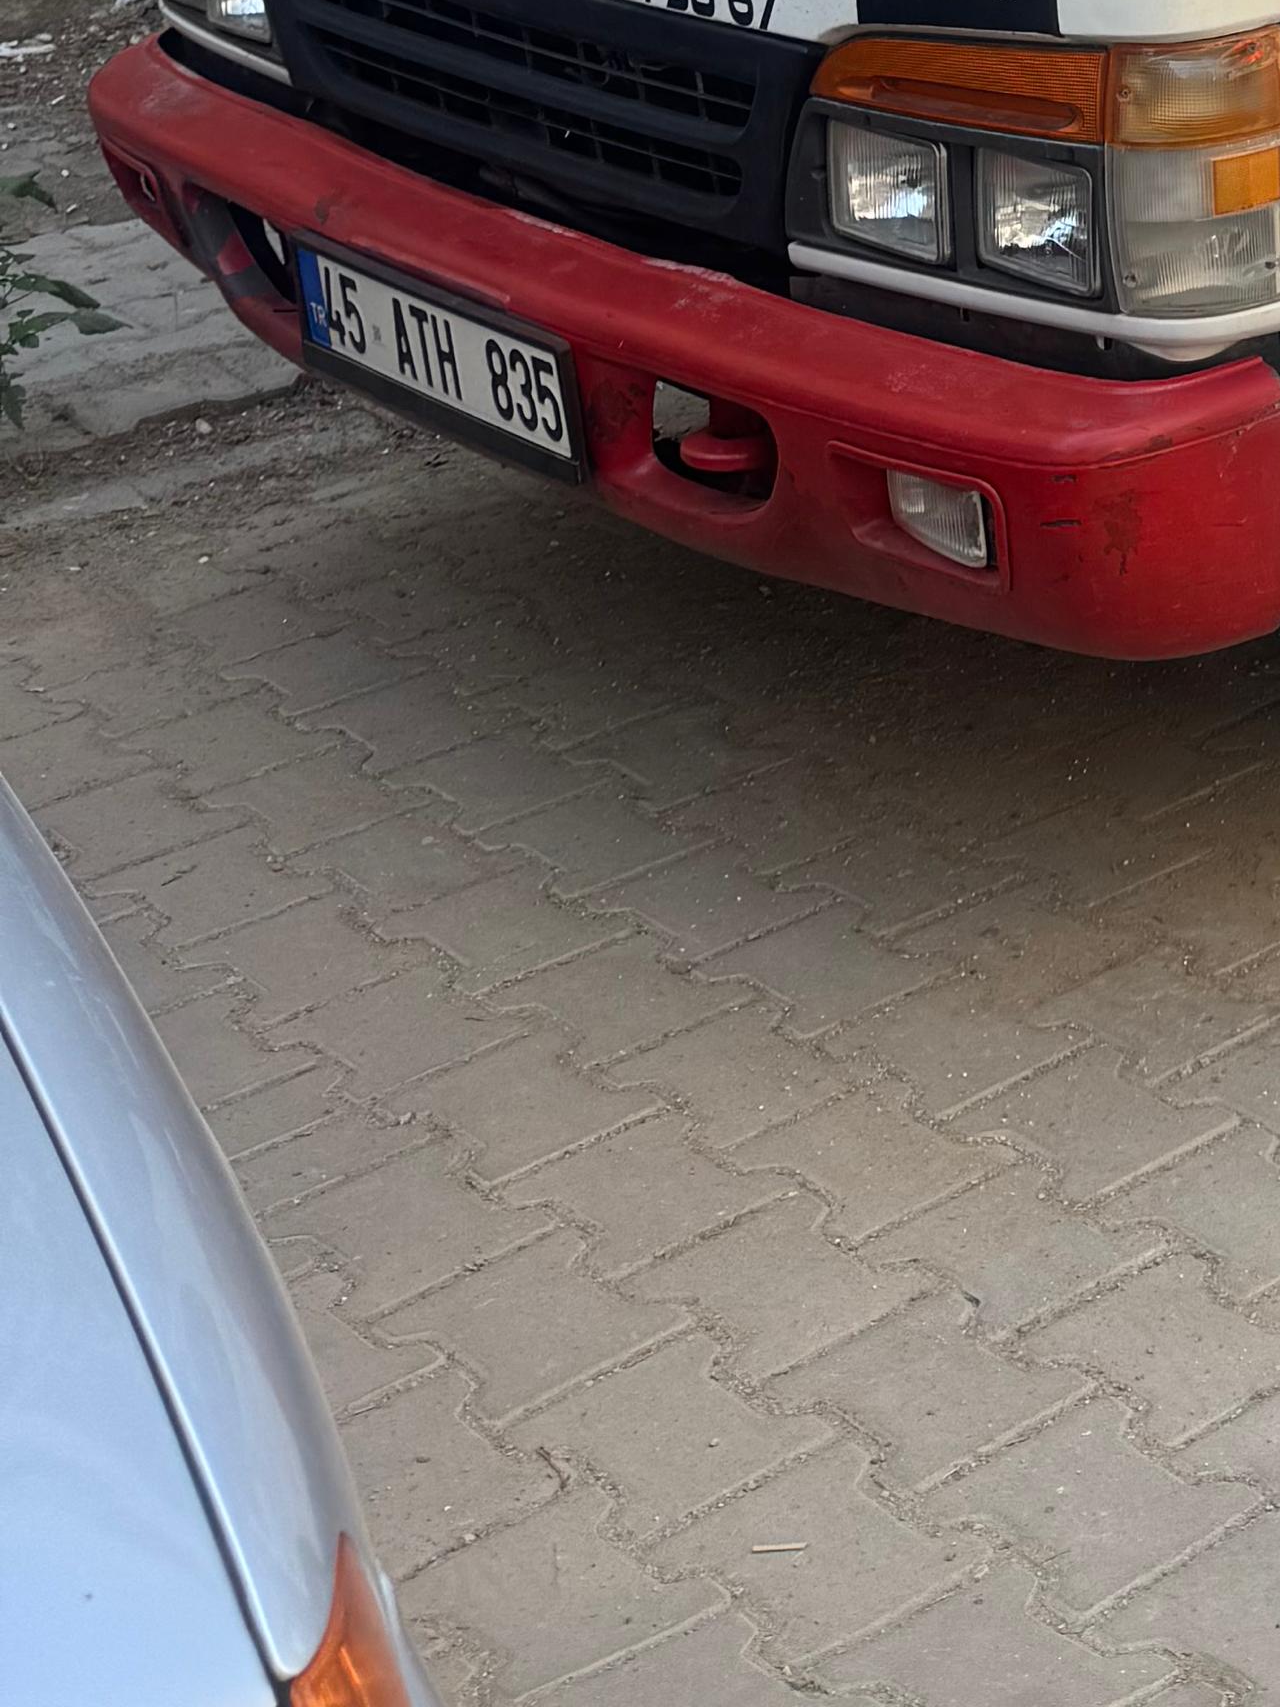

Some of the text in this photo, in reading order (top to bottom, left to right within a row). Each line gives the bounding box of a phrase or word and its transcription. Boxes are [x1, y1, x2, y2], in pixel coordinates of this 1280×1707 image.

[310, 266, 564, 442] TR 45 ATH 835
